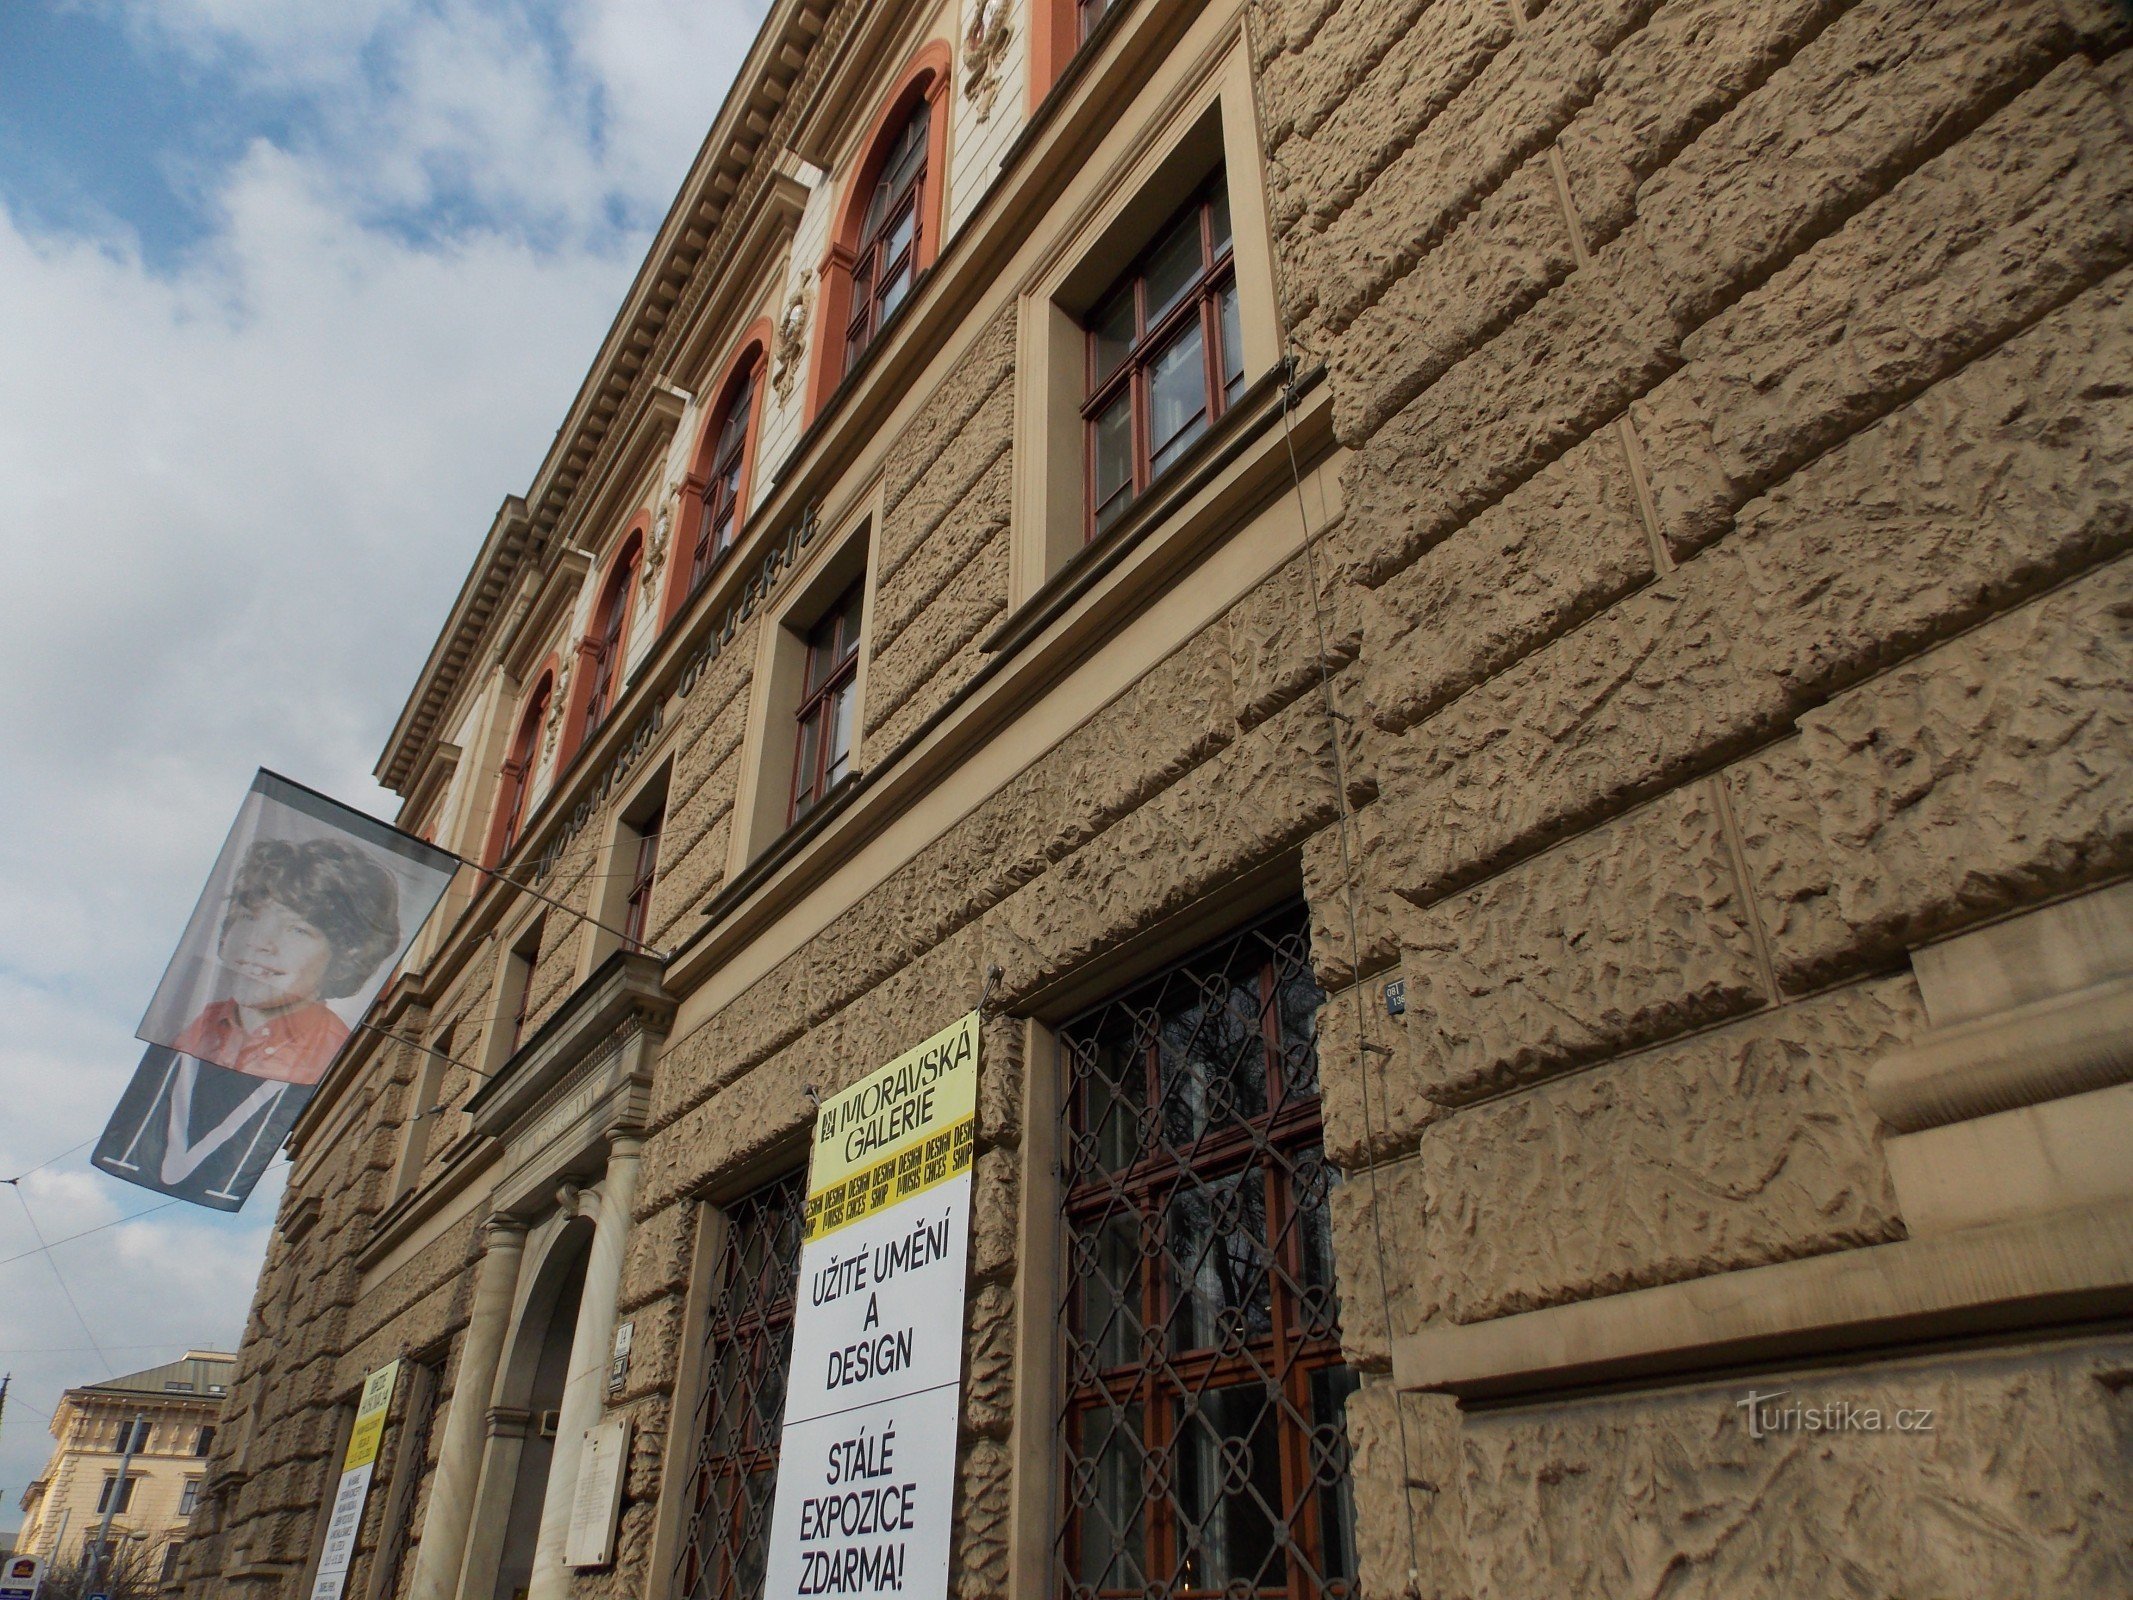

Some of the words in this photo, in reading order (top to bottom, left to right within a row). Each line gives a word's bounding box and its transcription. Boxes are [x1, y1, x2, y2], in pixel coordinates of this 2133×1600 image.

[841, 1021, 971, 1132] MORAVSKÁ
[845, 1086, 935, 1163] GALERIE
[898, 1145, 923, 1175] DESIGN
[925, 1130, 951, 1162] DESIGN
[813, 1243, 869, 1306] UŽITÉ
[874, 1206, 951, 1283] UMĚNÍ
[863, 1292, 879, 1331] A
[827, 1327, 913, 1390] DESIGN
[827, 1419, 895, 1485] STÁLÉ
[800, 1483, 916, 1540] EXPOZICE
[798, 1543, 905, 1594] ZDARMA!
